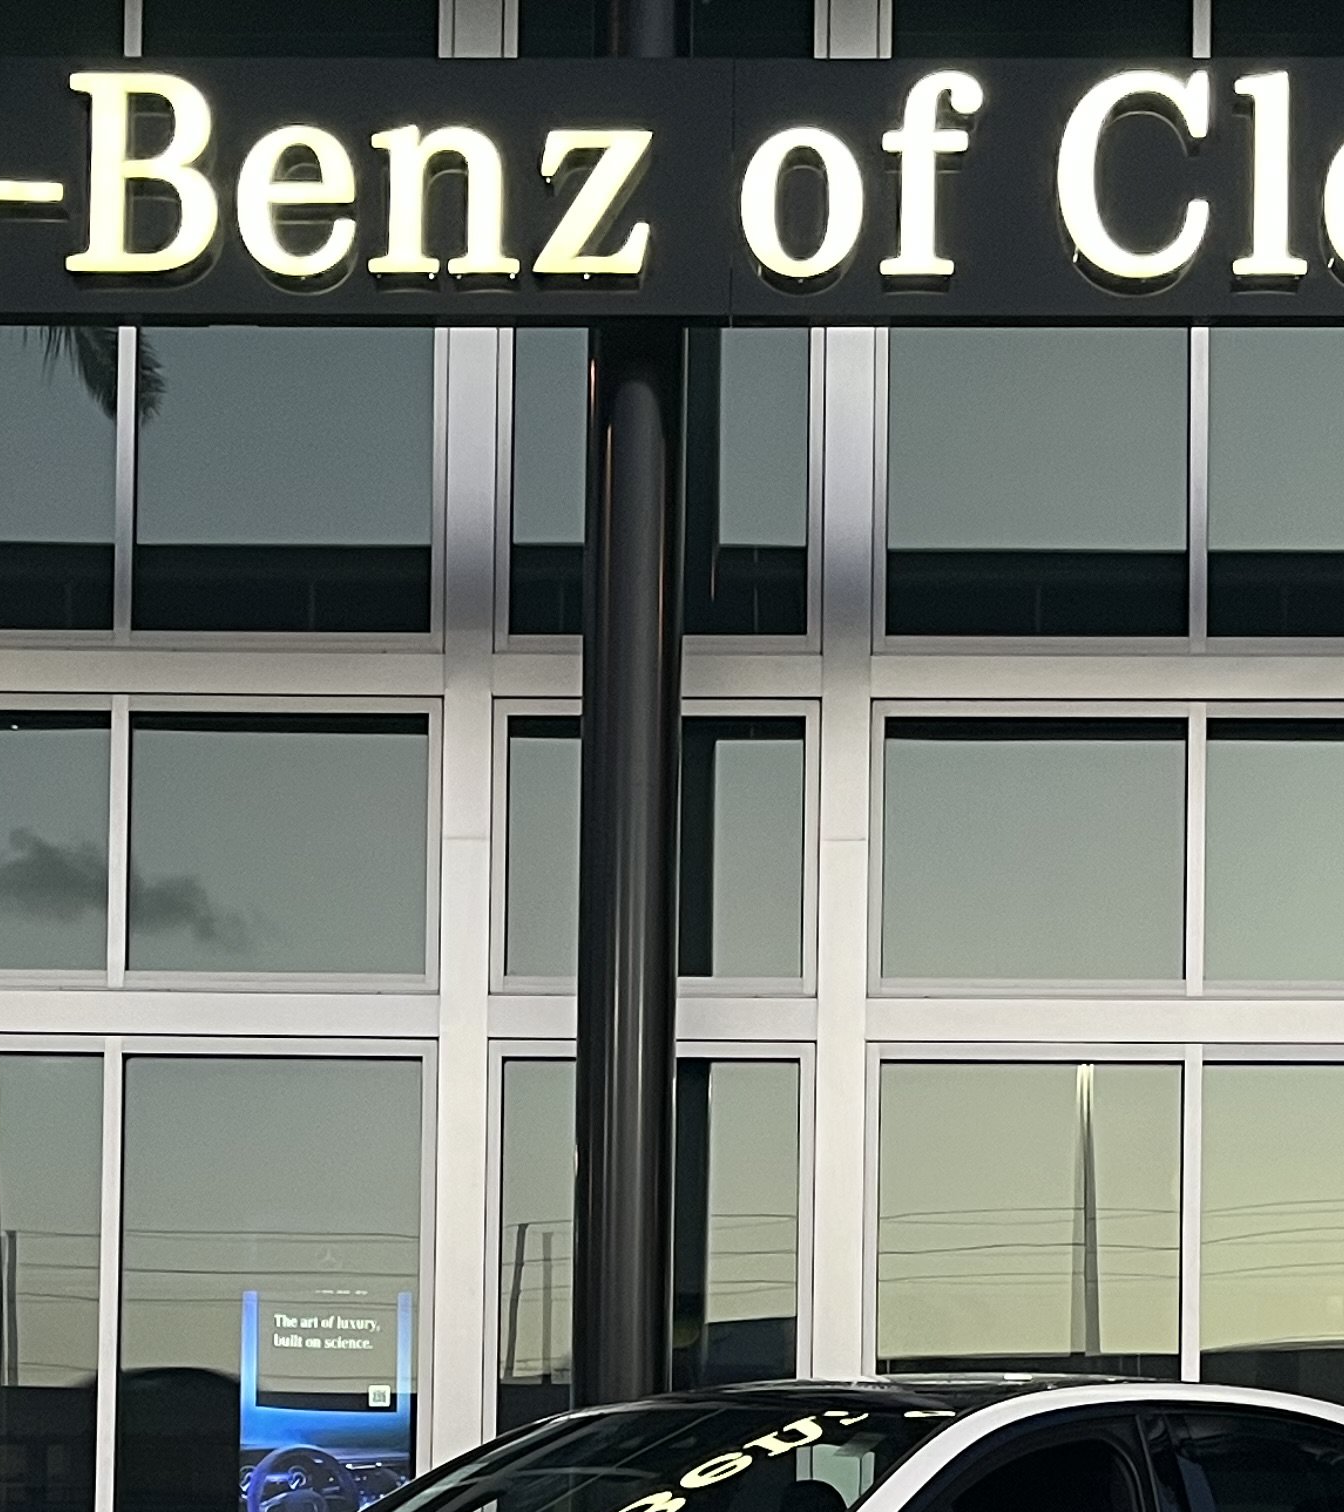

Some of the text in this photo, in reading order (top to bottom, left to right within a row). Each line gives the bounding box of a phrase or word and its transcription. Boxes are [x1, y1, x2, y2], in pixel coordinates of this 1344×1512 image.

[738, 70, 984, 278] of
[273, 1313, 381, 1333] The art of luxury,
[273, 1333, 374, 1349] built on science.
